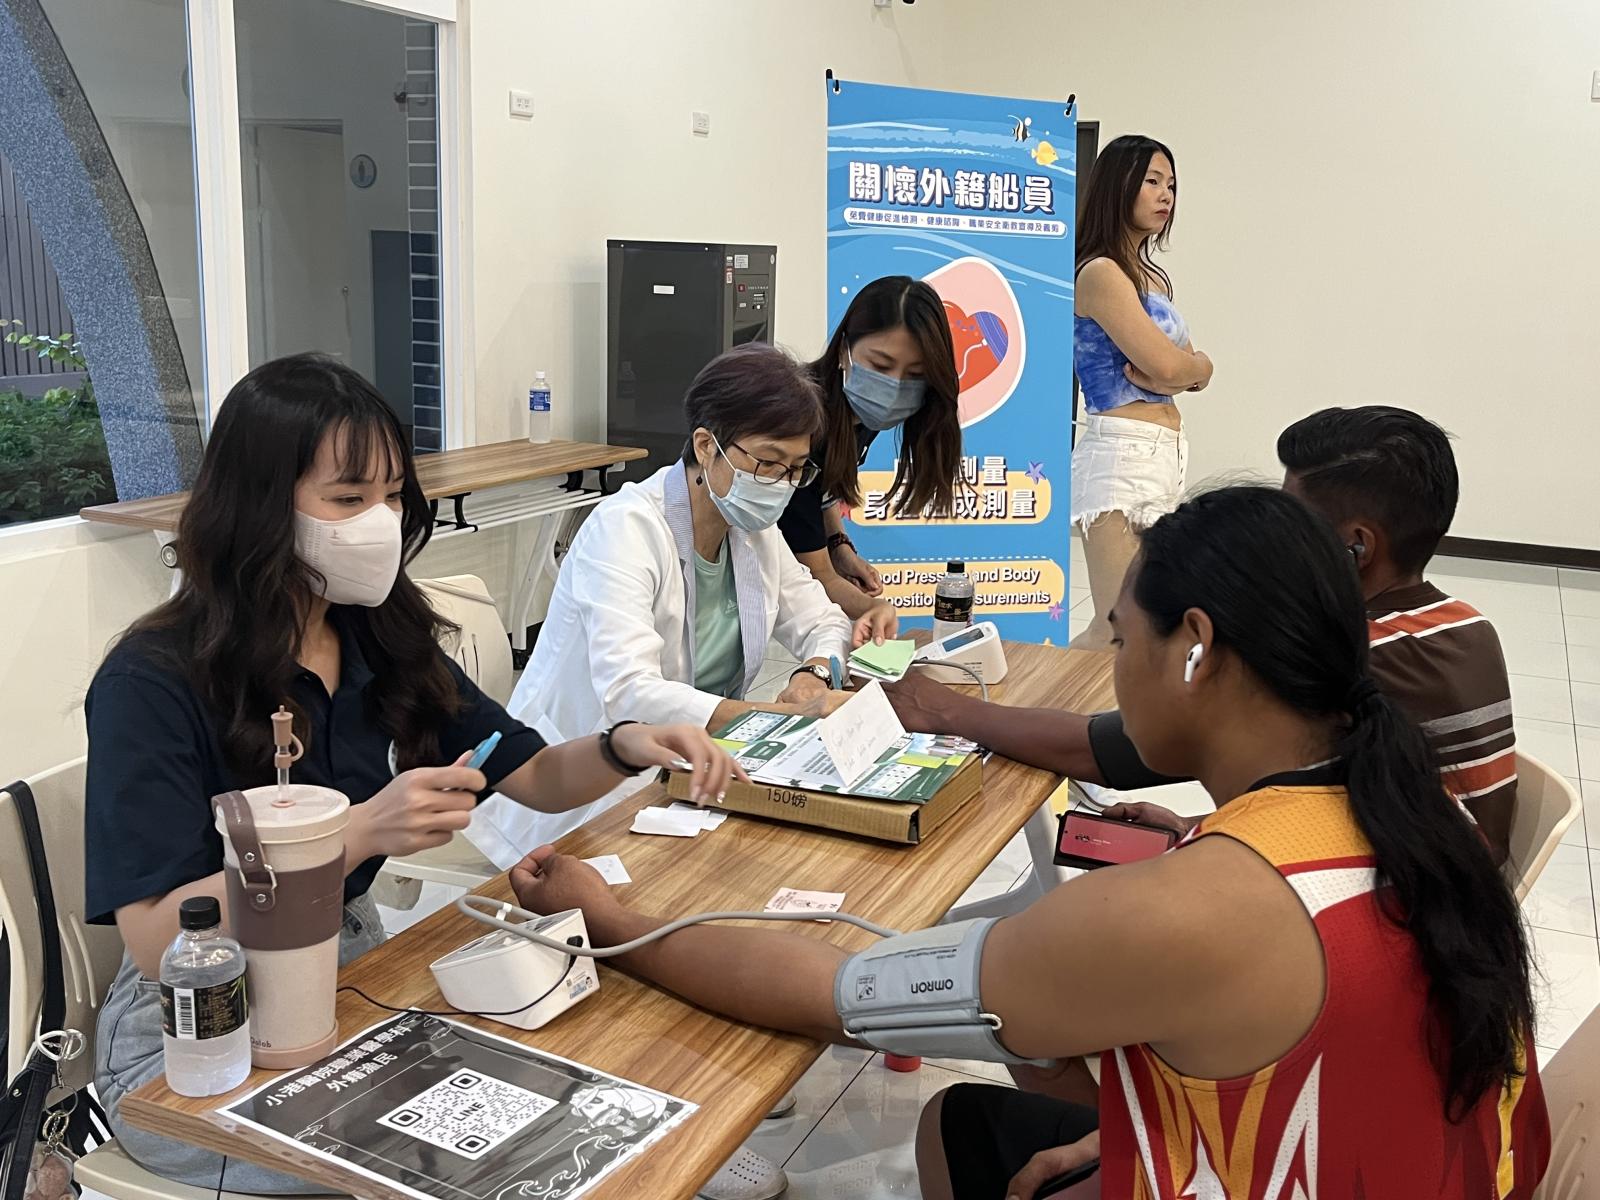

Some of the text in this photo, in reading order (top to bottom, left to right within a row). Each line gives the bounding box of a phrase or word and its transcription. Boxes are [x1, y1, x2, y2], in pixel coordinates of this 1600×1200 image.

[849, 161, 1055, 214] 關懷外籍船員
[1003, 567, 1040, 585] Body
[975, 591, 1050, 605] surements
[265, 1024, 412, 1107] 小港醫院職業醫學科
[326, 1052, 399, 1093] 外籍漁民
[452, 1101, 486, 1121] LINE
